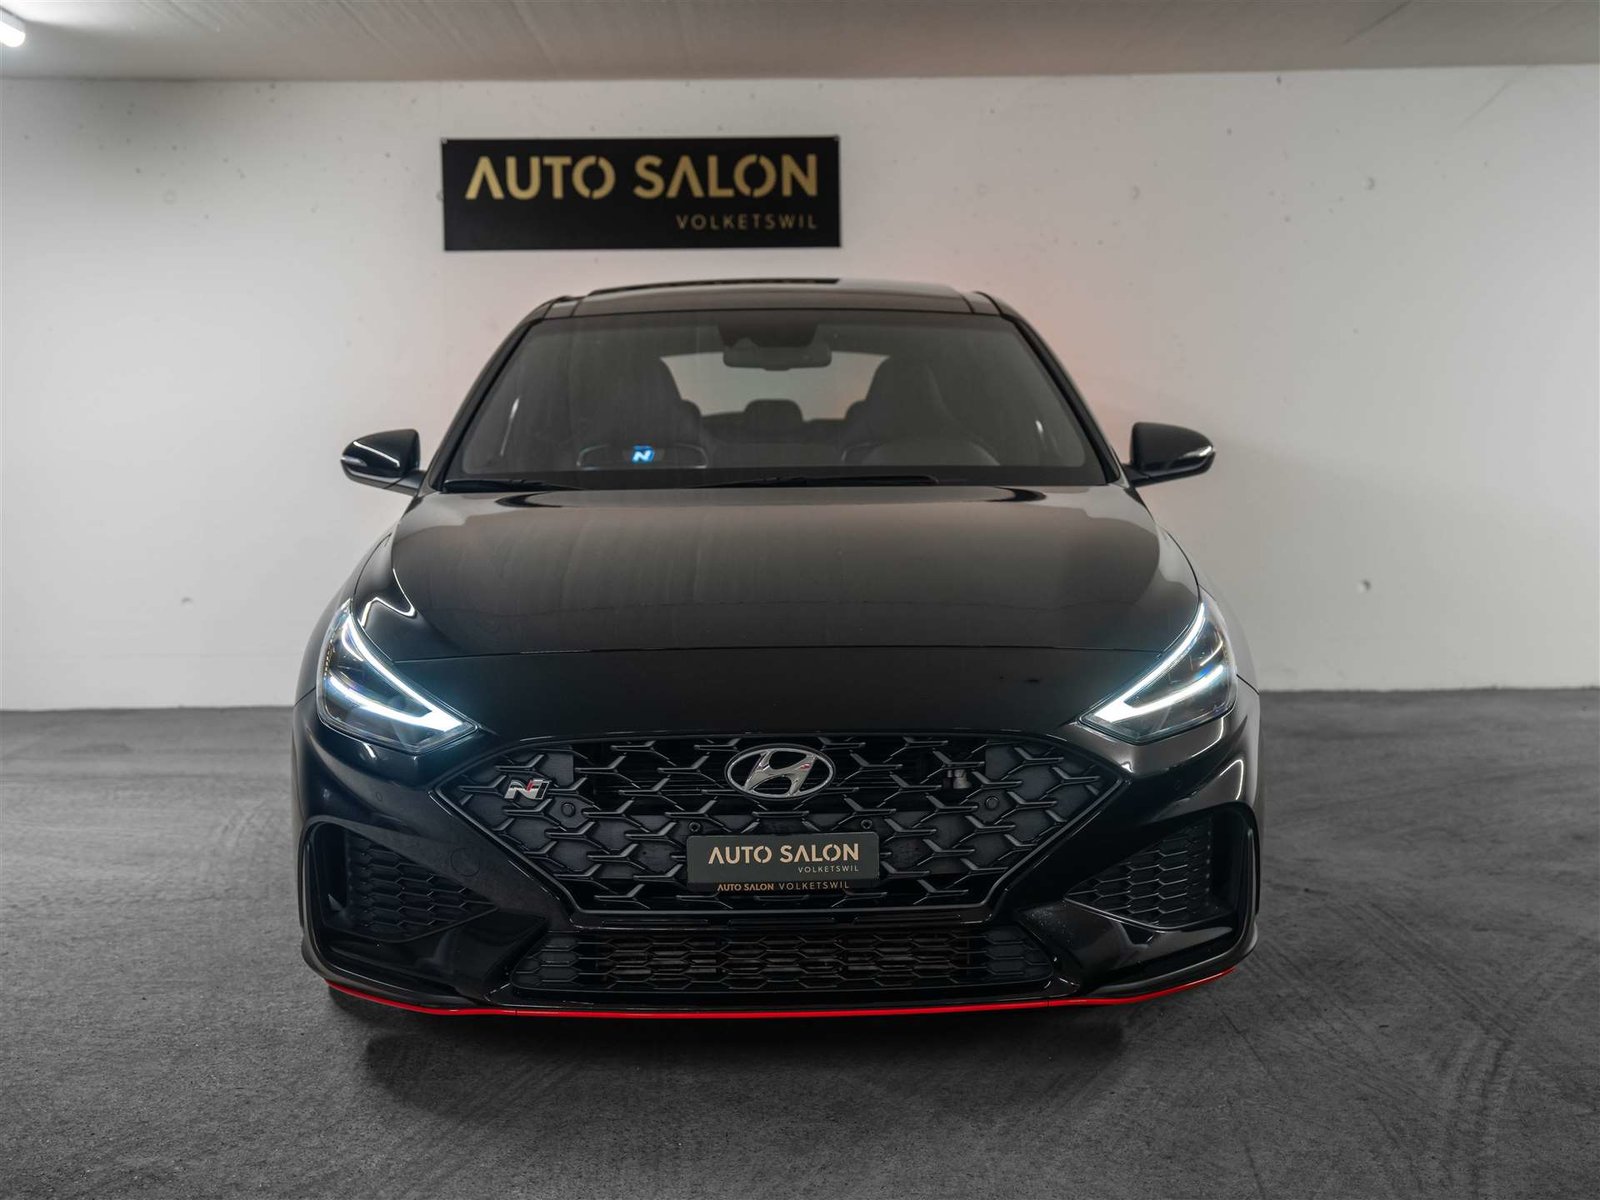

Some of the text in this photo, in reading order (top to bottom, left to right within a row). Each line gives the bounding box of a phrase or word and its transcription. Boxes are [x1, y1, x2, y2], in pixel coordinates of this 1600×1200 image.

[465, 154, 818, 200] AUTO SALON
[676, 213, 818, 231] VOLKETSWIL
[708, 843, 859, 864] AUTO SALON
[798, 864, 859, 873] VOLKETSWIL
[717, 881, 850, 892] AUTO SALON VOLKETSWIL
